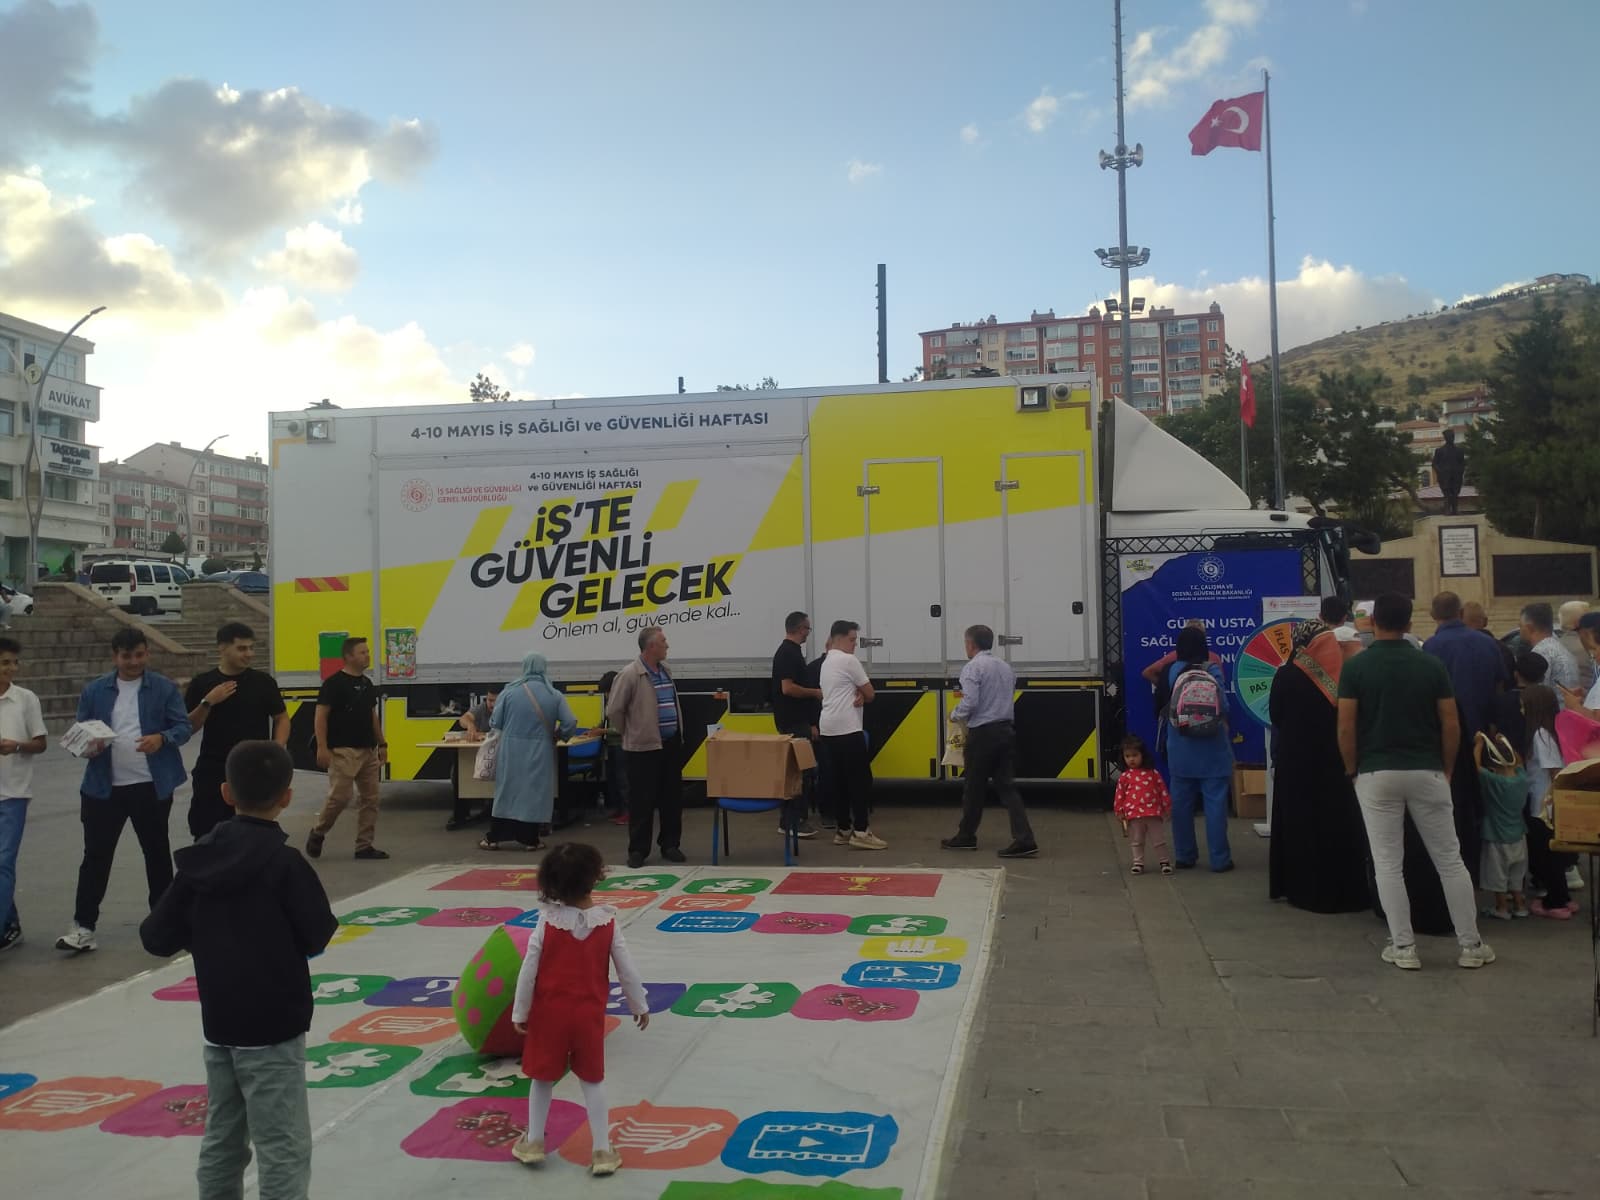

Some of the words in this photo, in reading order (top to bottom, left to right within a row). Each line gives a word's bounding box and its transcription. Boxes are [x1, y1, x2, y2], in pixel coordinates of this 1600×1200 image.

[48, 390, 91, 409] AVUKAT
[411, 427, 442, 440] 4-10
[447, 424, 494, 438] MAYIS
[499, 420, 513, 437] İŞ
[518, 418, 579, 434] SAĞLIĞI
[585, 421, 602, 432] ve
[607, 413, 694, 430] GÜVENLİĞİ
[699, 412, 769, 427] HAFTASI
[530, 472, 550, 480] 4-10
[554, 470, 584, 479] MAYIS
[587, 468, 596, 480] İŞ
[599, 468, 639, 478] SAĞLIĞI
[542, 480, 596, 492] GÜVENLİĞİ
[599, 480, 642, 490] HAFTASI
[539, 560, 735, 619] GELECEK
[542, 622, 598, 640] Önlem
[603, 618, 622, 635] al,
[626, 607, 702, 634] güvende
[1220, 618, 1256, 628] USTA
[1249, 681, 1268, 694] PAS
